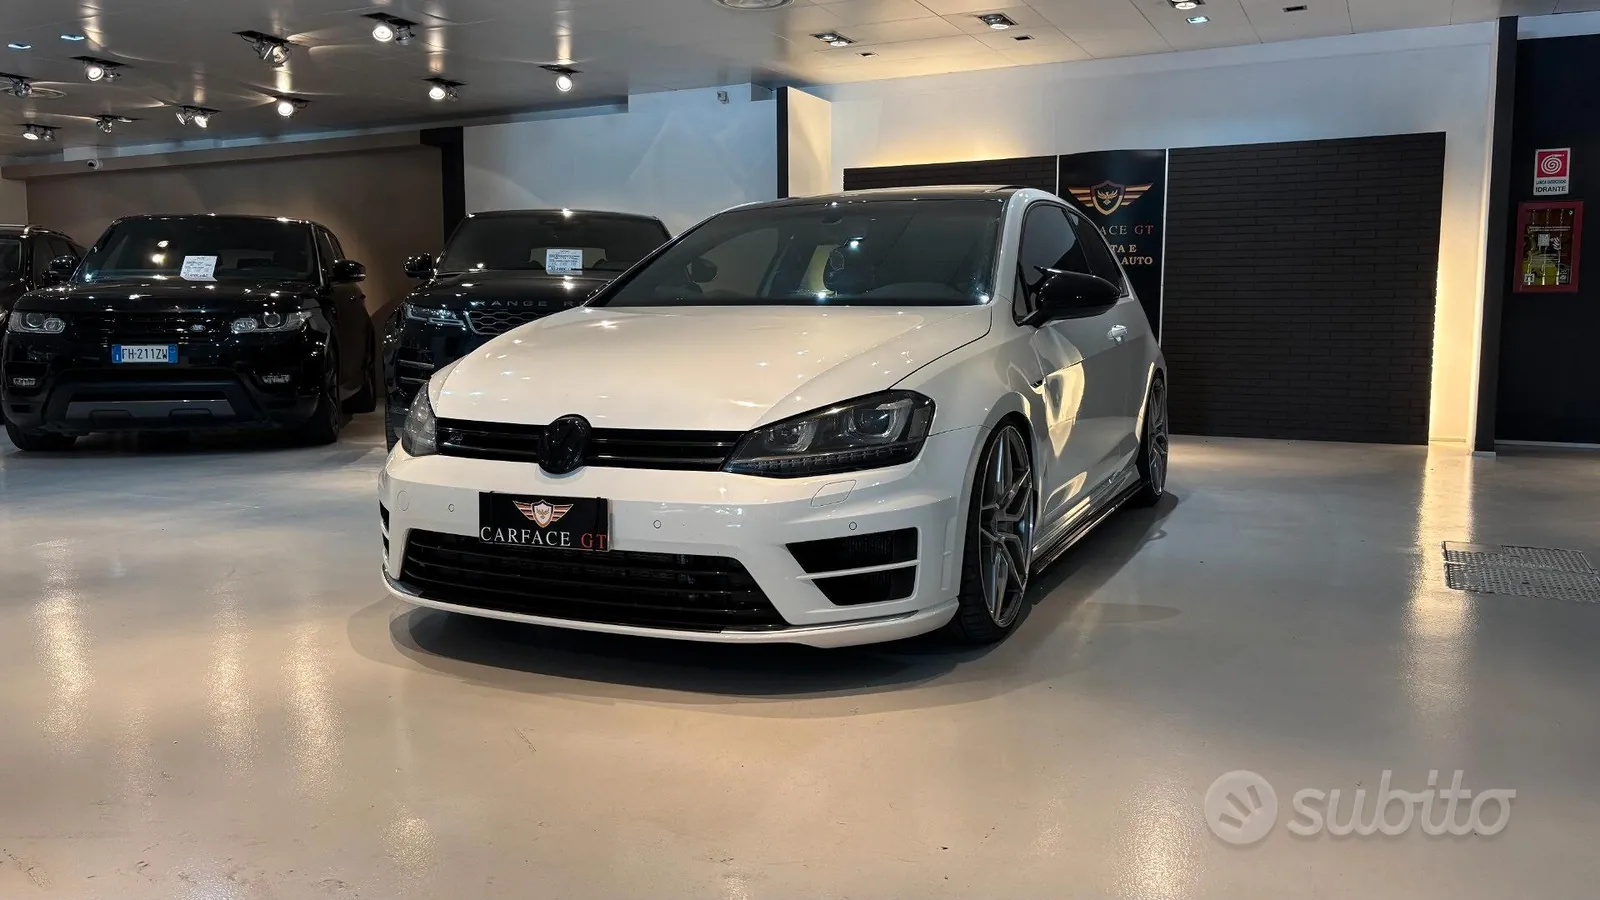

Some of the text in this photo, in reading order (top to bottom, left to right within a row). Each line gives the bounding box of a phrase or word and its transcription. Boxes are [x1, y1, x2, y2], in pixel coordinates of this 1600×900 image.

[1134, 225, 1154, 235] GT
[1129, 244, 1137, 253] E
[1121, 256, 1153, 265] AUTO
[480, 526, 607, 549] CARFACE GT
